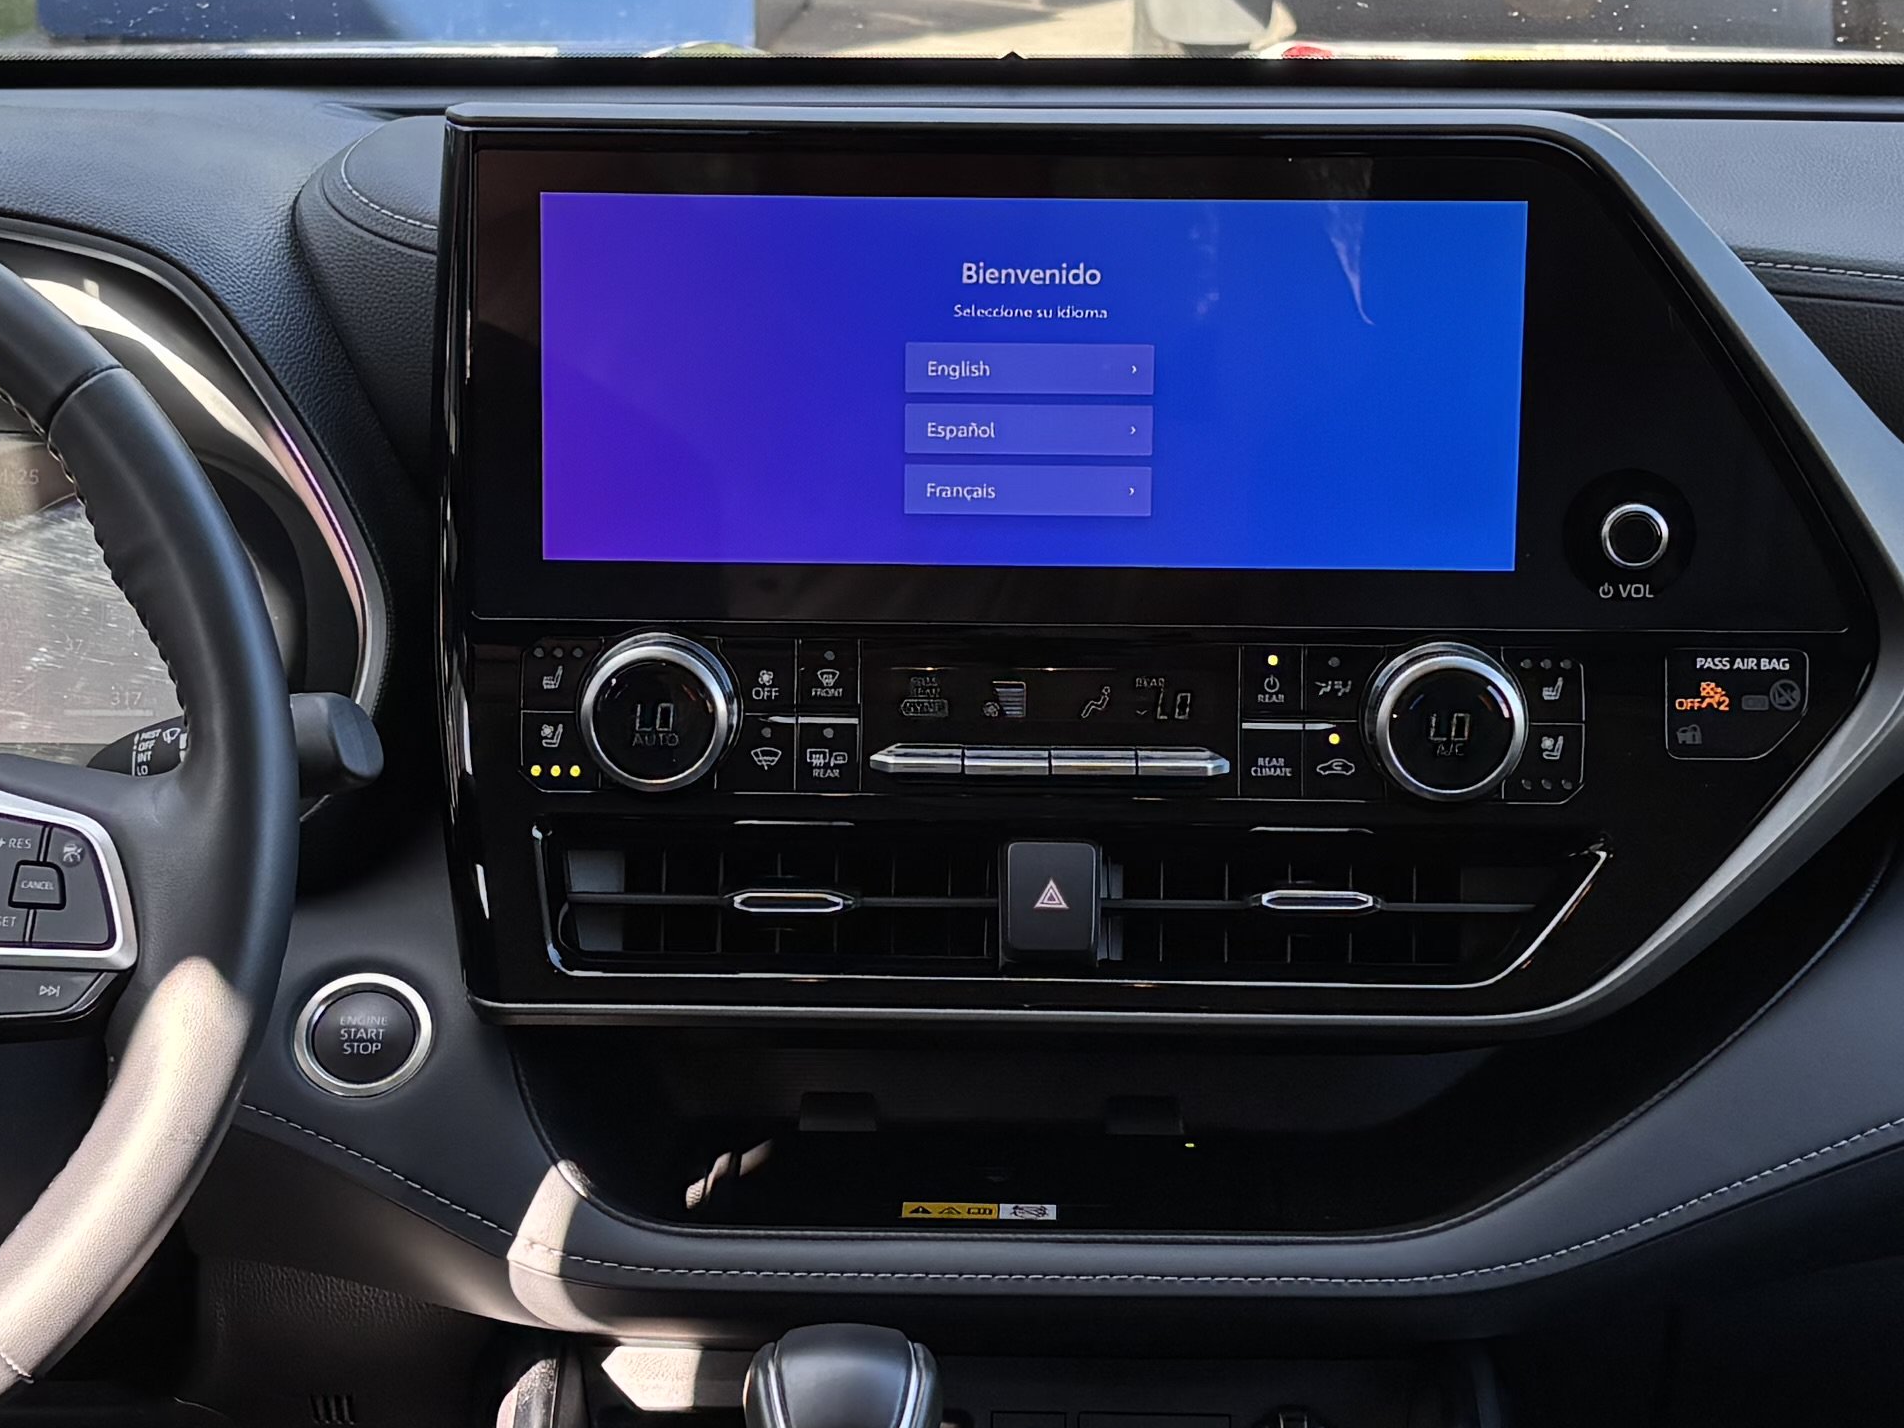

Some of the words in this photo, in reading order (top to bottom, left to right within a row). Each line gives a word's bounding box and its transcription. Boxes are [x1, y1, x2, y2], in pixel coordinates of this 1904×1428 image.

[962, 261, 1102, 285] Bienvenido
[953, 303, 1033, 319] Seleccione
[1036, 308, 1053, 319] su
[1057, 305, 1108, 319] idioma
[927, 360, 991, 380] English
[926, 422, 996, 441] Español
[926, 483, 996, 501] Français
[1619, 583, 1654, 598] VOL
[1696, 657, 1731, 669] PASS
[1733, 658, 1758, 670] AIR
[1760, 658, 1791, 670] BAG
[752, 688, 779, 700] OFF
[811, 688, 844, 698] FRONT
[1257, 694, 1285, 703] REAR
[1675, 698, 1702, 710] OFF
[138, 740, 156, 752] OFF
[632, 733, 680, 747] AUTO
[137, 751, 152, 763] INT
[1257, 757, 1285, 767] REAR
[812, 767, 841, 779] REAR
[1251, 767, 1293, 777] CLIMATE
[8, 837, 33, 849] RES
[20, 880, 55, 890] CANCEL
[339, 1015, 388, 1026] ENGINE
[339, 1028, 386, 1041] START
[343, 1042, 382, 1055] STOP
